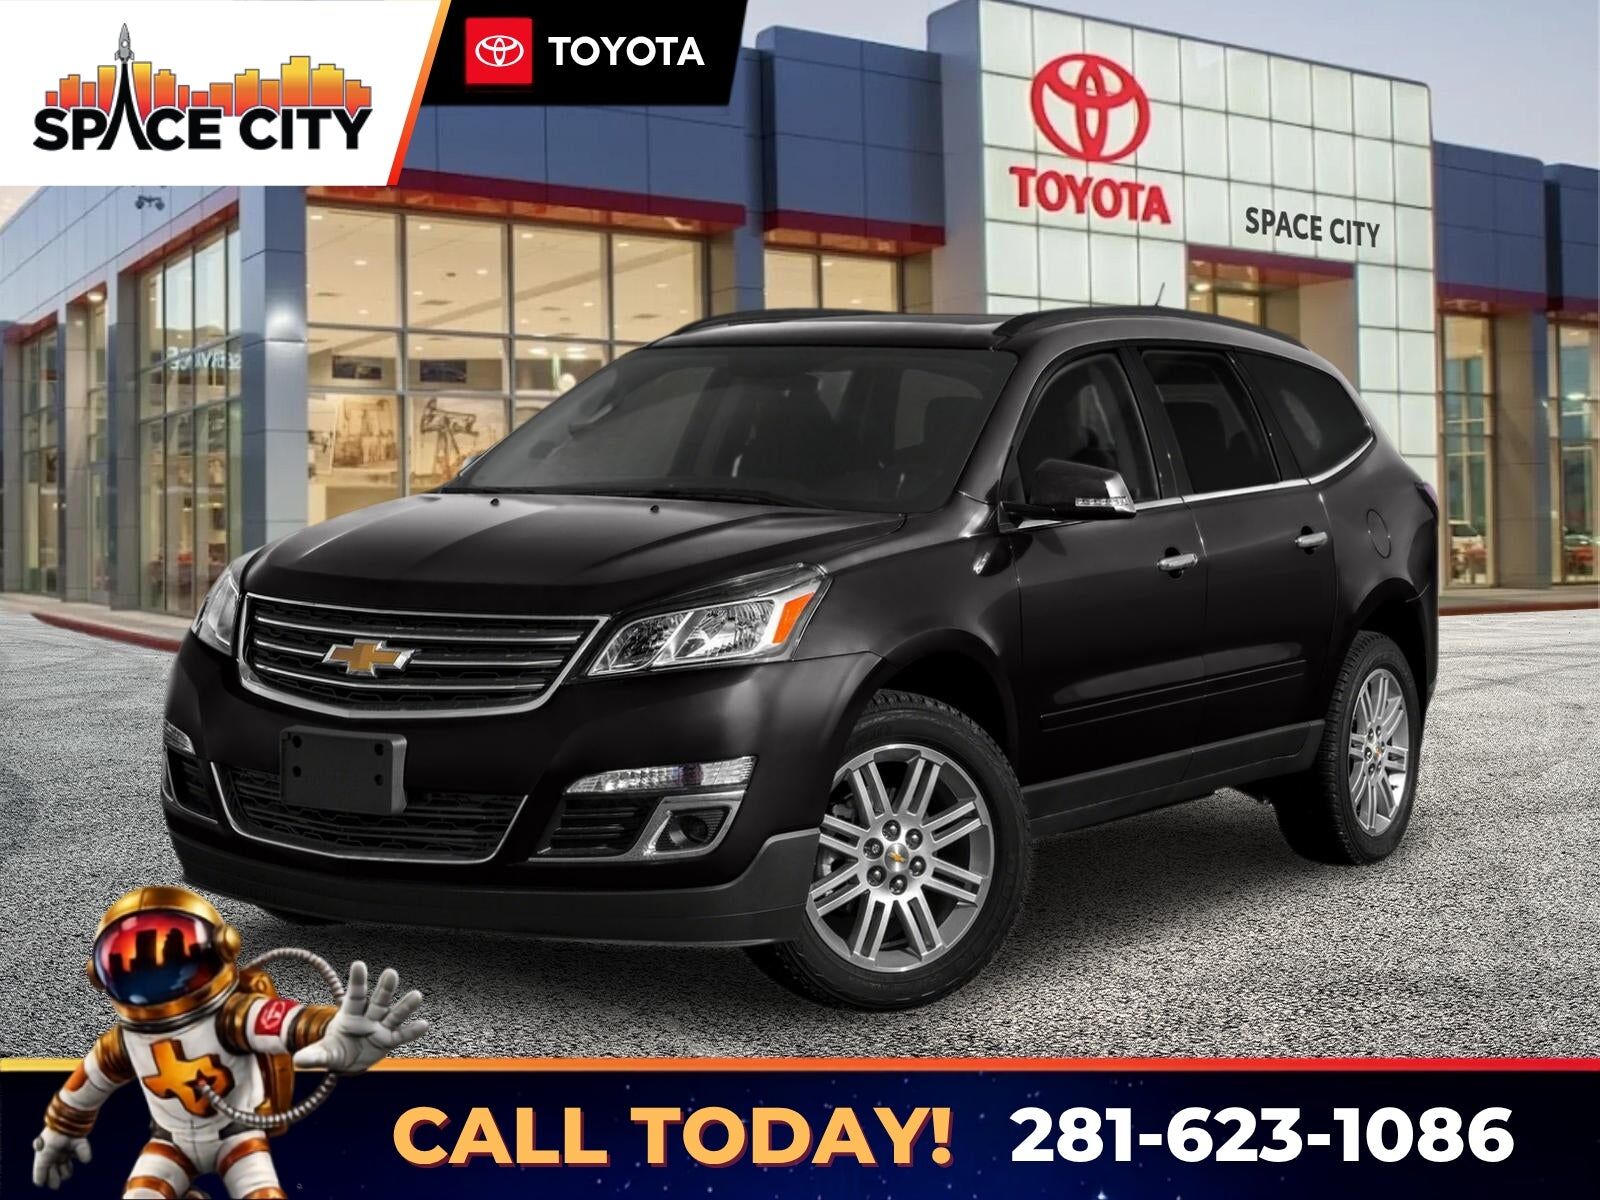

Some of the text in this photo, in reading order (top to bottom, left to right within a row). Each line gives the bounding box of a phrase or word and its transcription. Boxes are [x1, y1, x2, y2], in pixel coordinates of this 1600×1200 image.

[1009, 166, 1171, 224] TOYOTA
[1245, 206, 1380, 248] SPACE CITY
